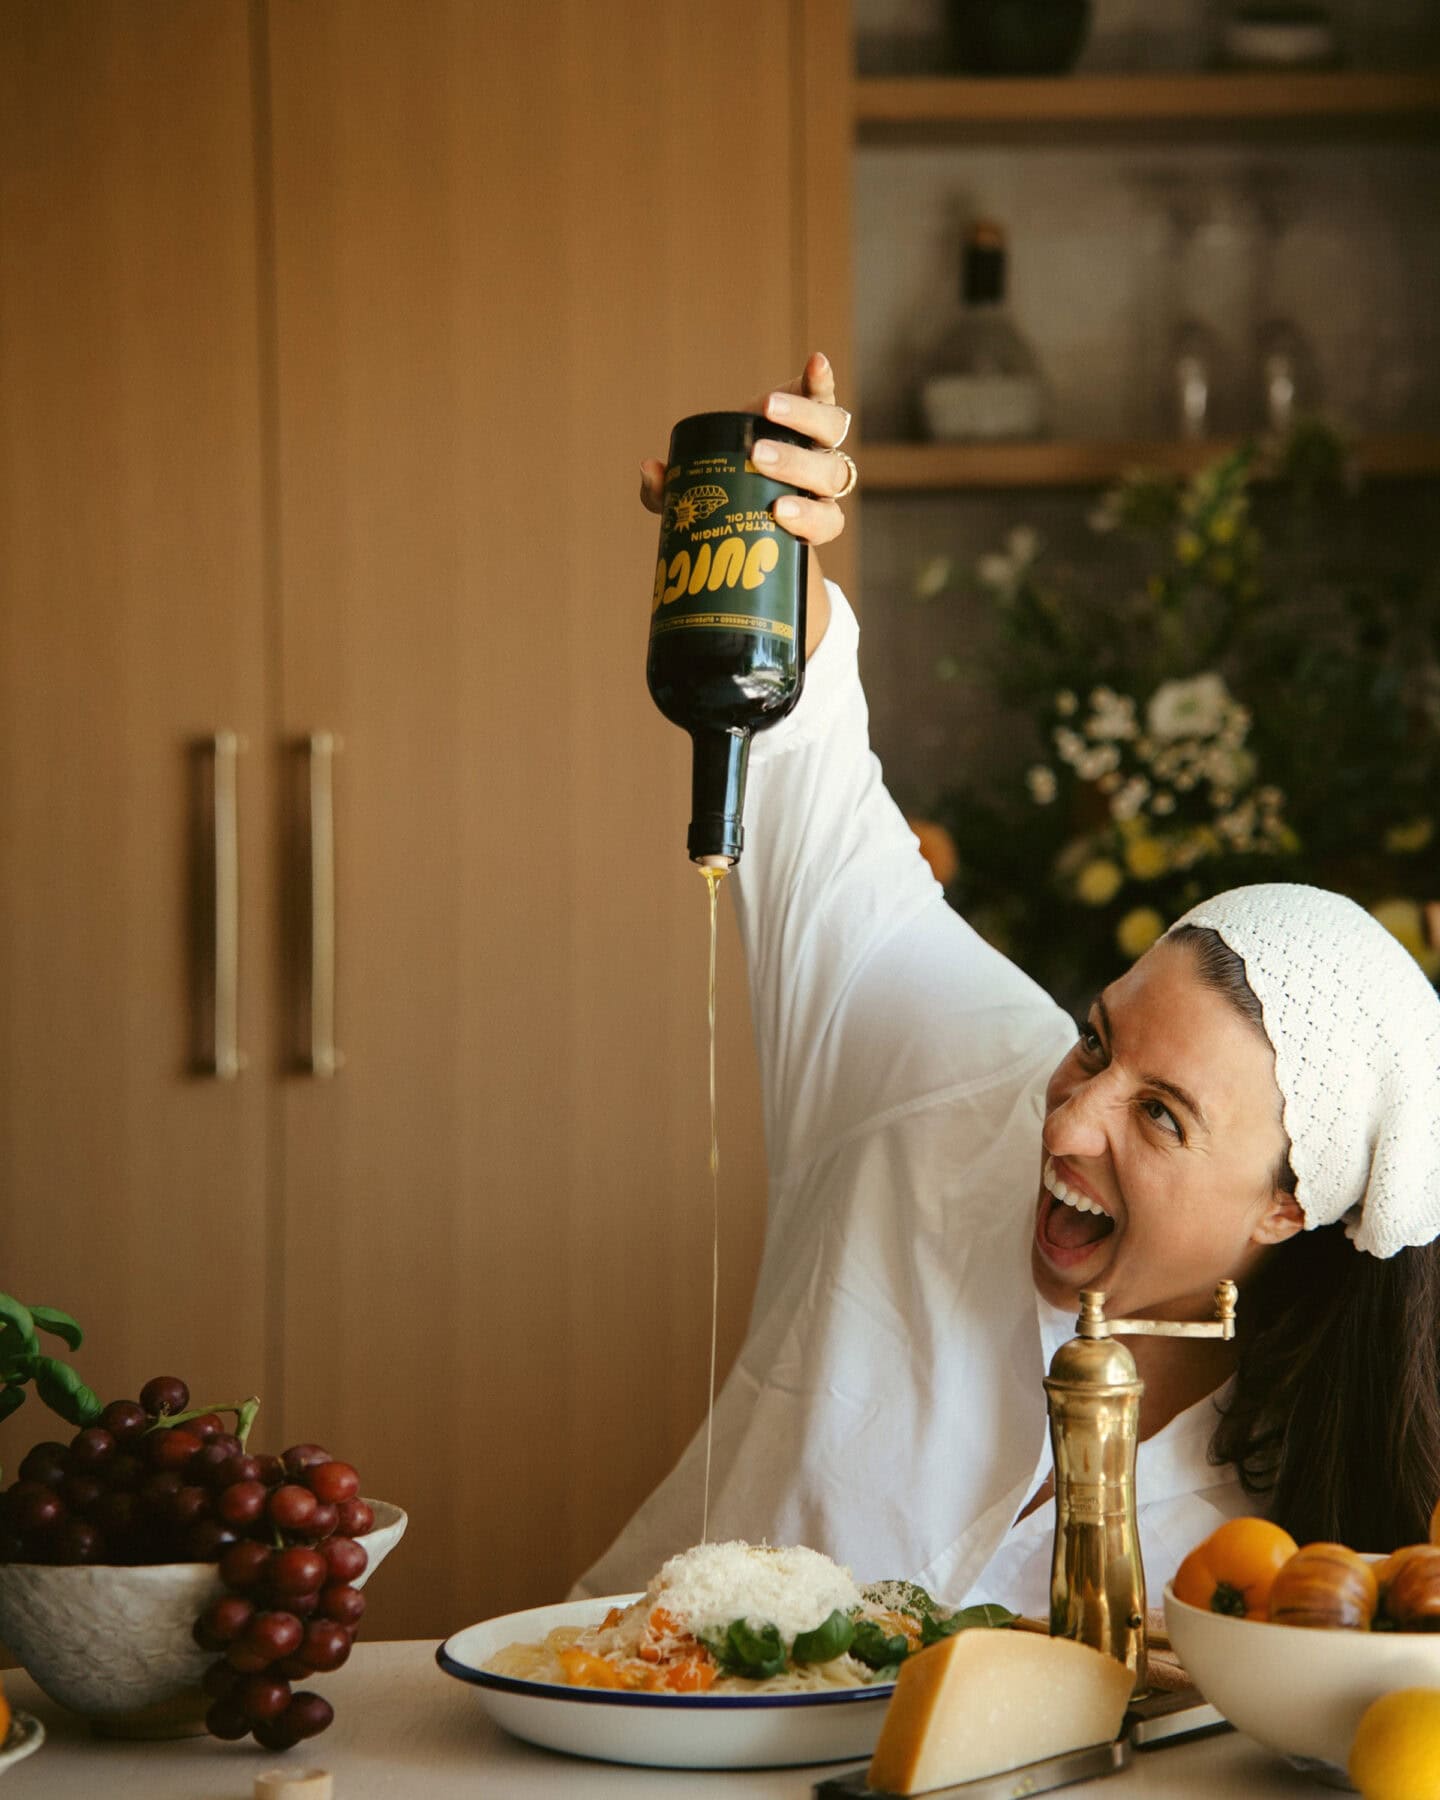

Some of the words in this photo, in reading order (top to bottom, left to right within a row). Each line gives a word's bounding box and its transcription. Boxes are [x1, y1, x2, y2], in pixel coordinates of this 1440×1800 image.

[725, 512, 743, 524] OIL
[745, 511, 776, 521] OLIVE
[736, 520, 776, 532] EXTRA
[691, 524, 732, 542] VIRGIN
